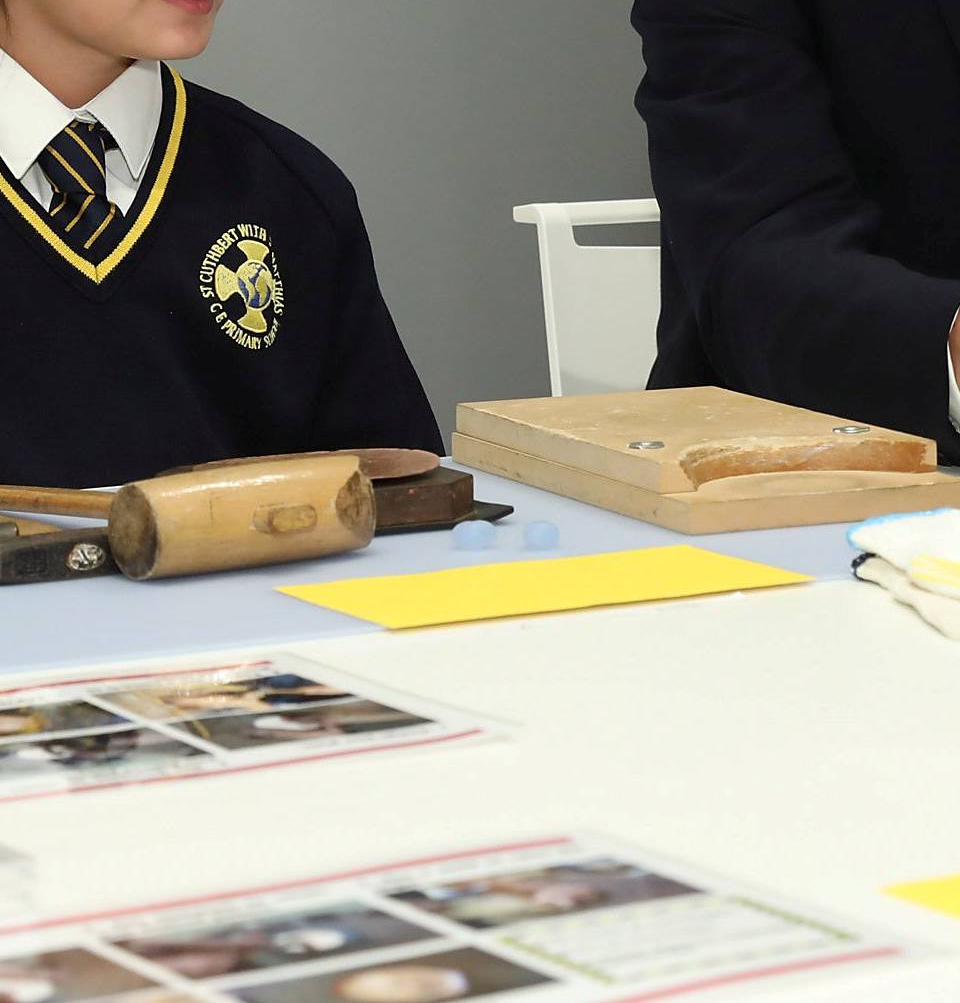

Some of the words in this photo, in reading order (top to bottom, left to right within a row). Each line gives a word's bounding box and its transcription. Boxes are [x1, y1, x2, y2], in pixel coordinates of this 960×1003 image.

[237, 223, 267, 242] WITH
[200, 228, 239, 283] CUTHBERT
[200, 285, 215, 298] ST
[220, 319, 262, 350] PRIMARY
